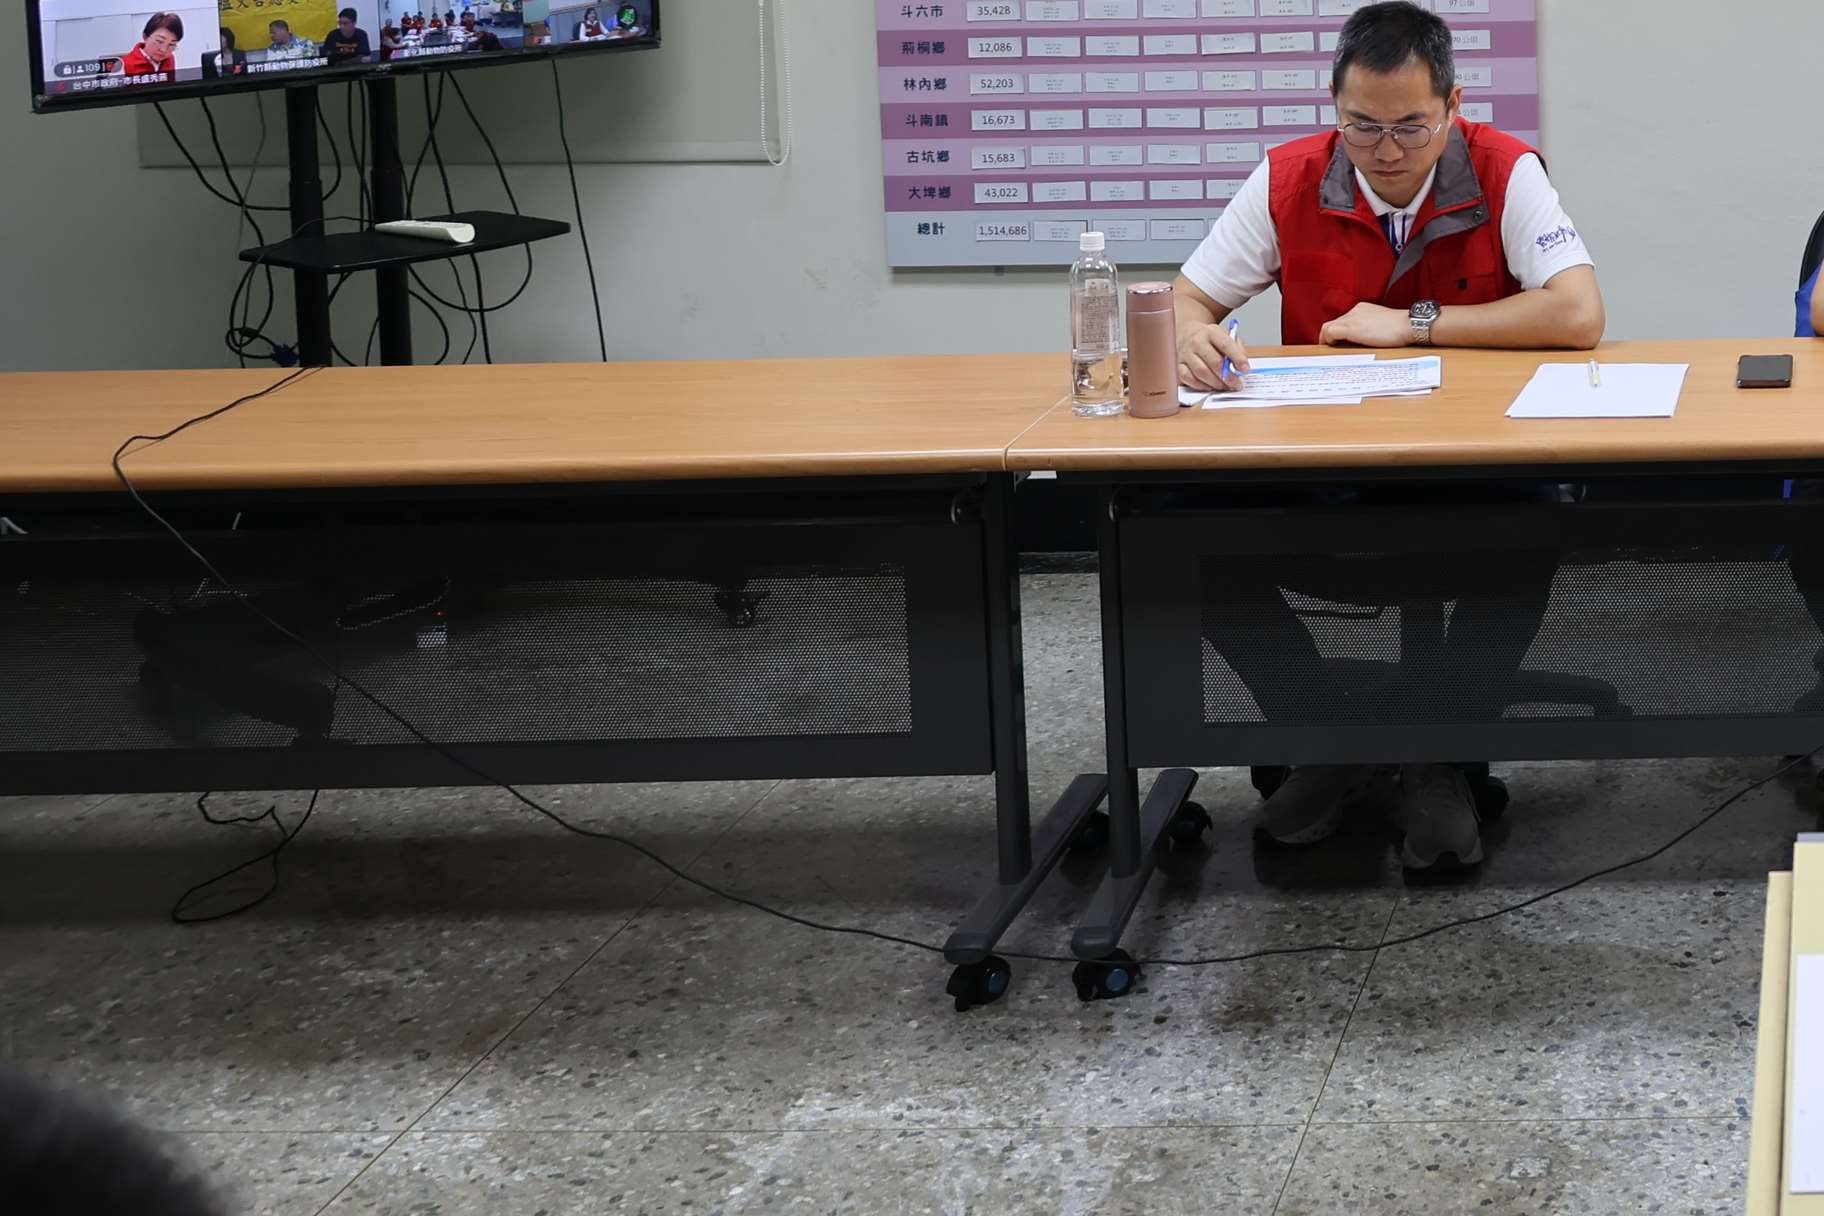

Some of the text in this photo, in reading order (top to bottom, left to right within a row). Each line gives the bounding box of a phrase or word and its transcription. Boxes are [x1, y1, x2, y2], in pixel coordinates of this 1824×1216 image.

[901, 6, 944, 18] 斗六市
[977, 6, 1011, 16] 35,428
[979, 43, 1012, 53] 12,086
[85, 63, 100, 72] 109
[904, 78, 947, 90] 林內鄉
[980, 79, 1014, 89] 52,203
[905, 114, 948, 127] 斗南鎮
[982, 116, 1016, 125] 16,673
[907, 151, 950, 163] 古坑鄉
[982, 154, 1015, 163] 15,683
[908, 186, 951, 199] 大埤鄉
[984, 188, 1018, 198] 43,022
[917, 222, 945, 235] 總計
[979, 226, 1027, 236] 1,514,686
